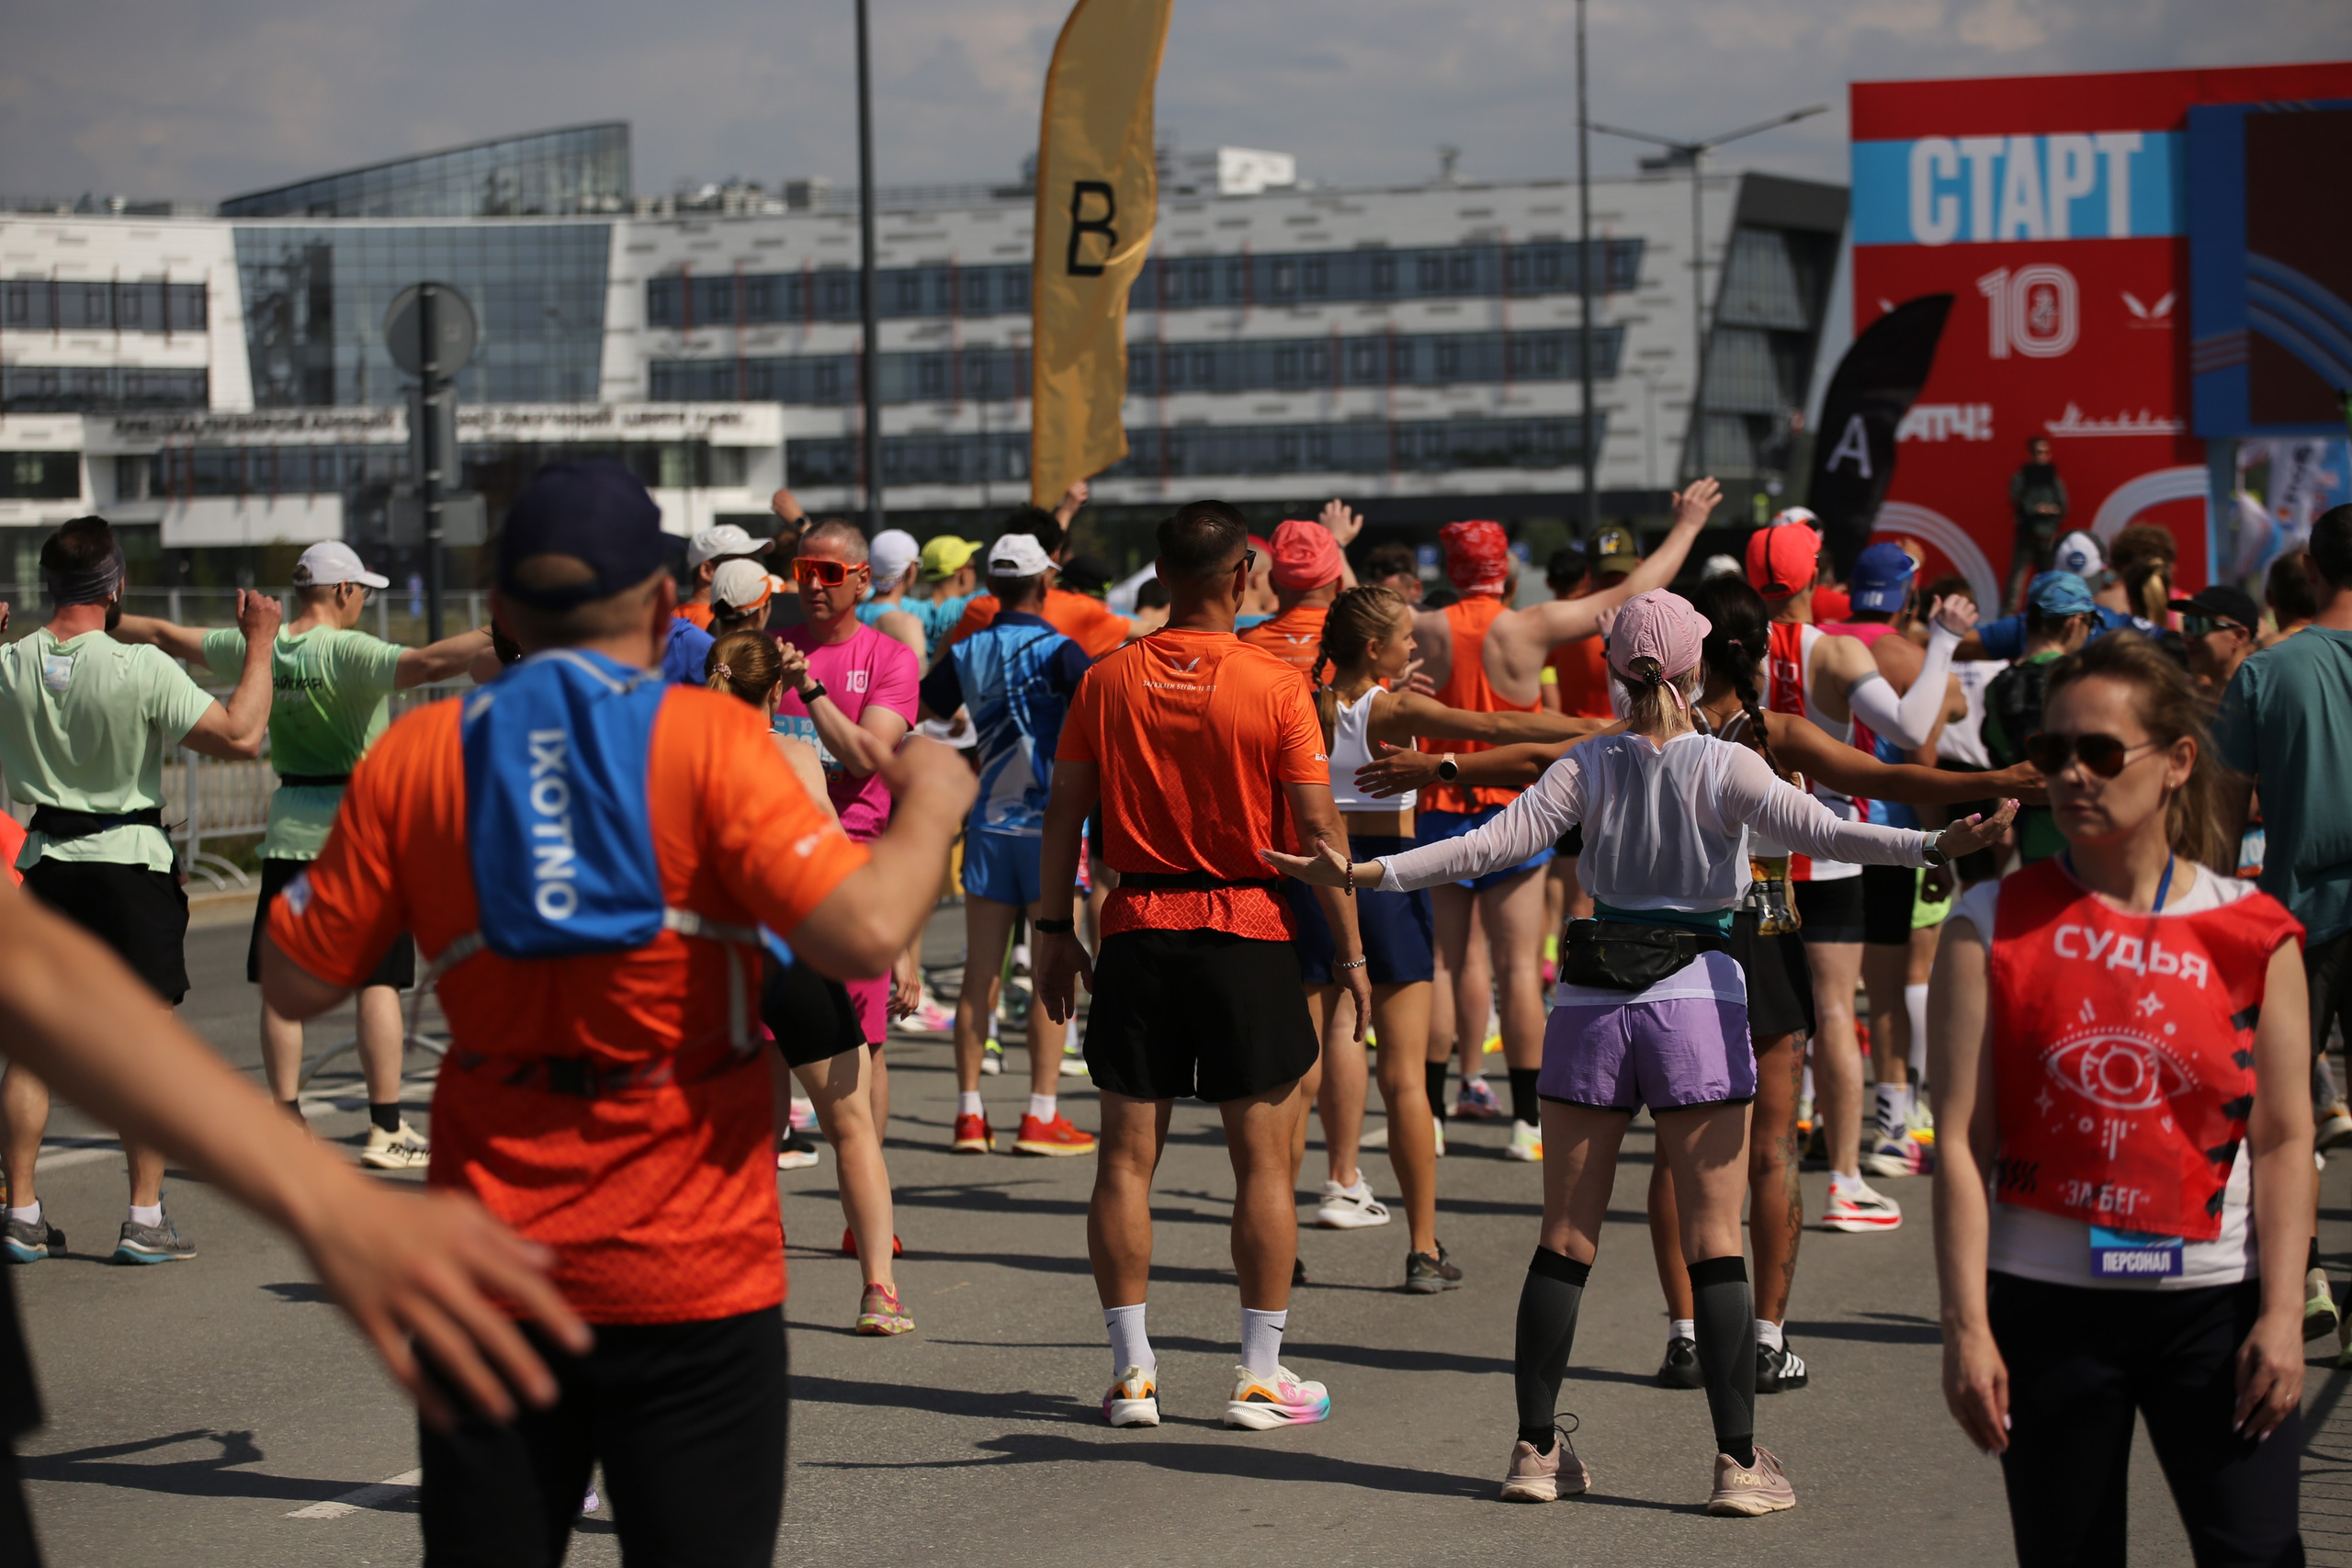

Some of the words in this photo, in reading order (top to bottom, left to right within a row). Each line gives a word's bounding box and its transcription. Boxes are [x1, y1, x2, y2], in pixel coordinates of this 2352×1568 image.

[1911, 132, 2142, 245] СТАРТ
[1975, 263, 2080, 360] 10
[1894, 401, 1994, 442] АТЧ!
[845, 670, 869, 694] 10
[1142, 680, 1175, 690] ЗАРЯЖАЕМ
[1176, 683, 1196, 692] БЕГОМ
[2053, 924, 2208, 990] СУДЬЯ
[2102, 1250, 2171, 1273] ПЕРСОНАЛ
[1733, 1472, 1761, 1486] HOKA
